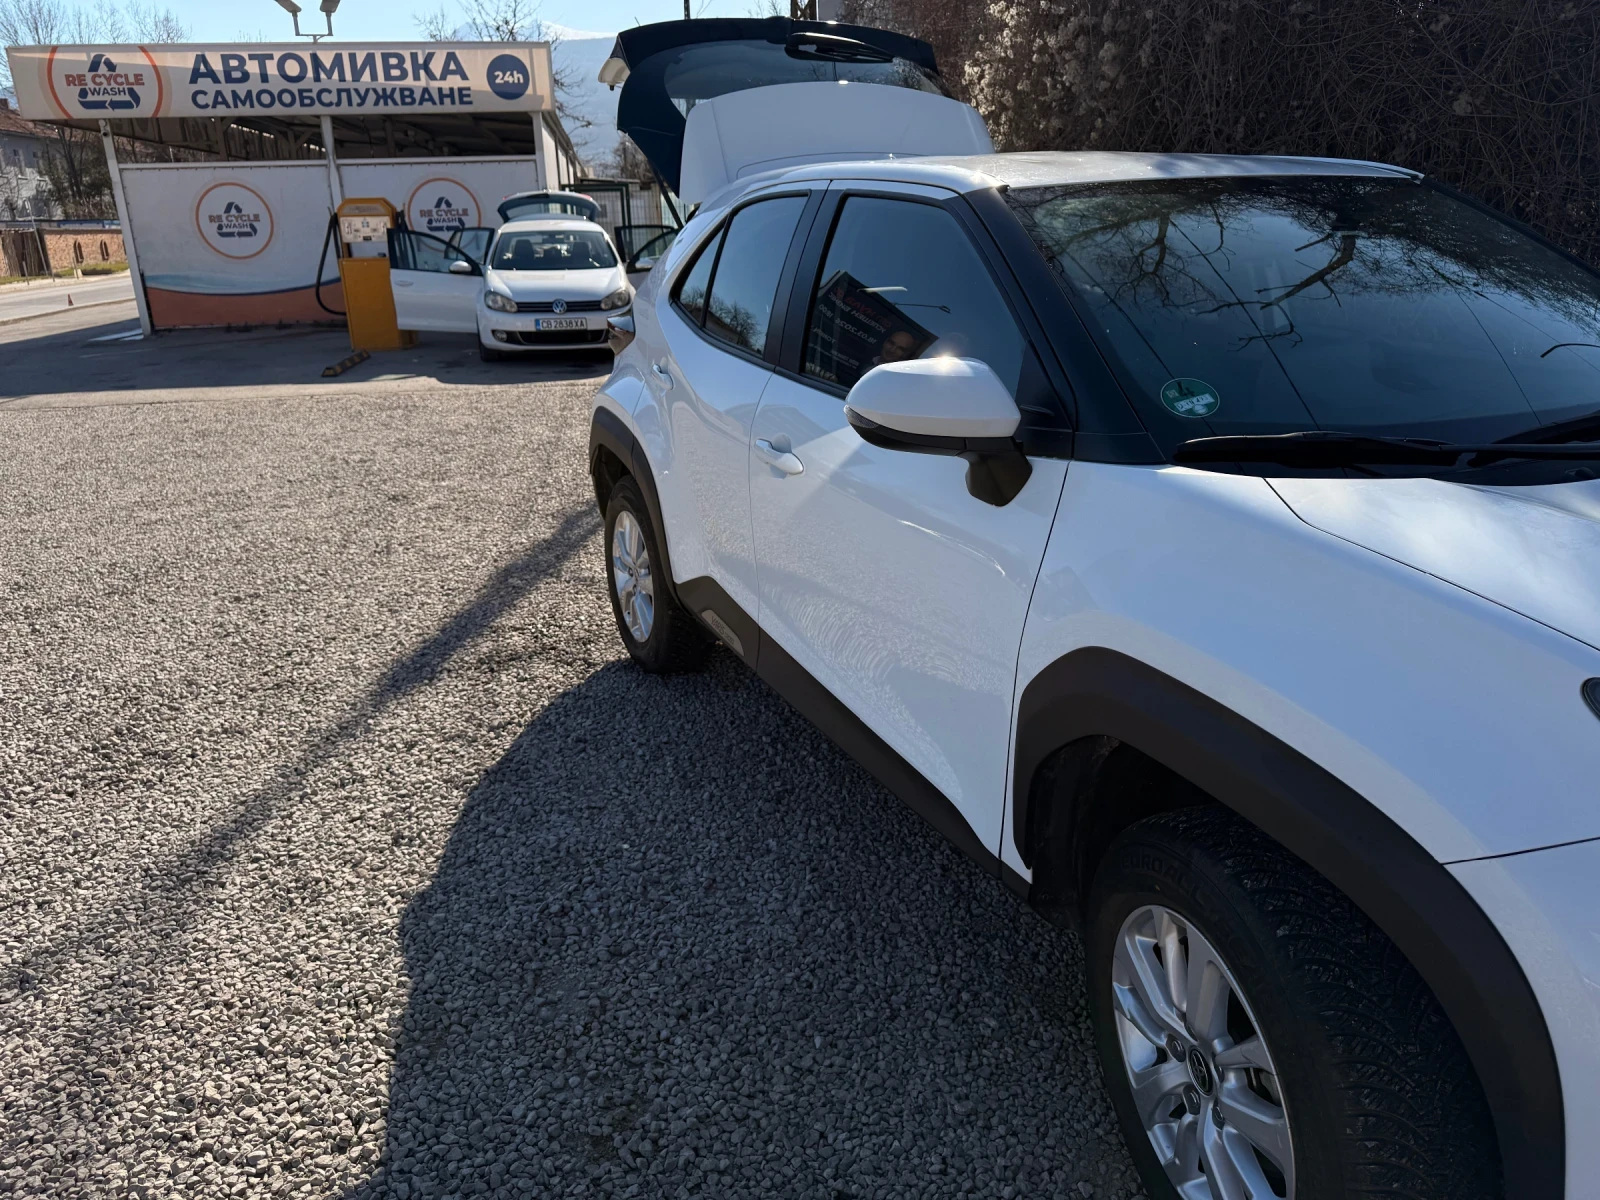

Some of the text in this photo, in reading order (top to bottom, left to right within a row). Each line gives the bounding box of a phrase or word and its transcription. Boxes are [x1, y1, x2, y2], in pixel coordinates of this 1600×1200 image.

[188, 52, 470, 84] АВТОМИВКА
[64, 73, 145, 87] RE CYCLE
[494, 70, 524, 84] 24h
[88, 87, 127, 97] WASH
[191, 86, 474, 110] САМООБСЛУЖВАНЕ
[208, 213, 260, 223] RE CYCLE
[419, 208, 469, 218] RE CYCLE
